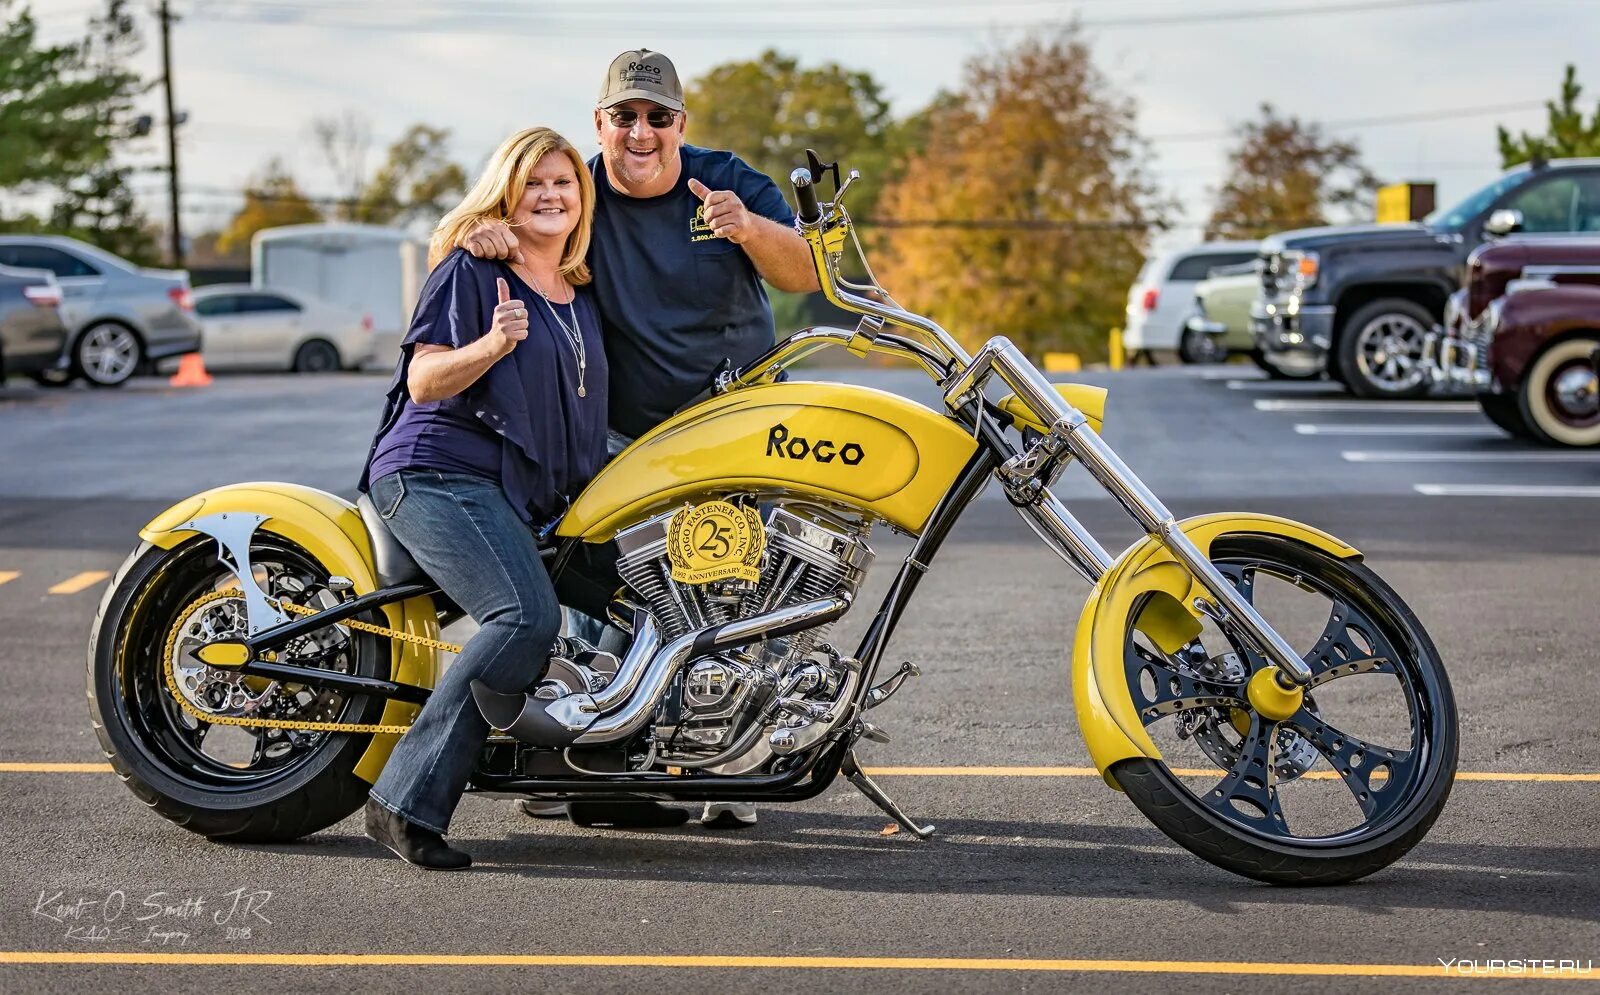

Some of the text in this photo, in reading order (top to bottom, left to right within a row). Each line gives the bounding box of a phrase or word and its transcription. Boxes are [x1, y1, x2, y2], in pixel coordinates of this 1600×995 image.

[687, 504, 735, 527] FASTENER
[682, 528, 694, 558] ROGO
[674, 566, 757, 581] 1992 ANNIVERSARY 2017
